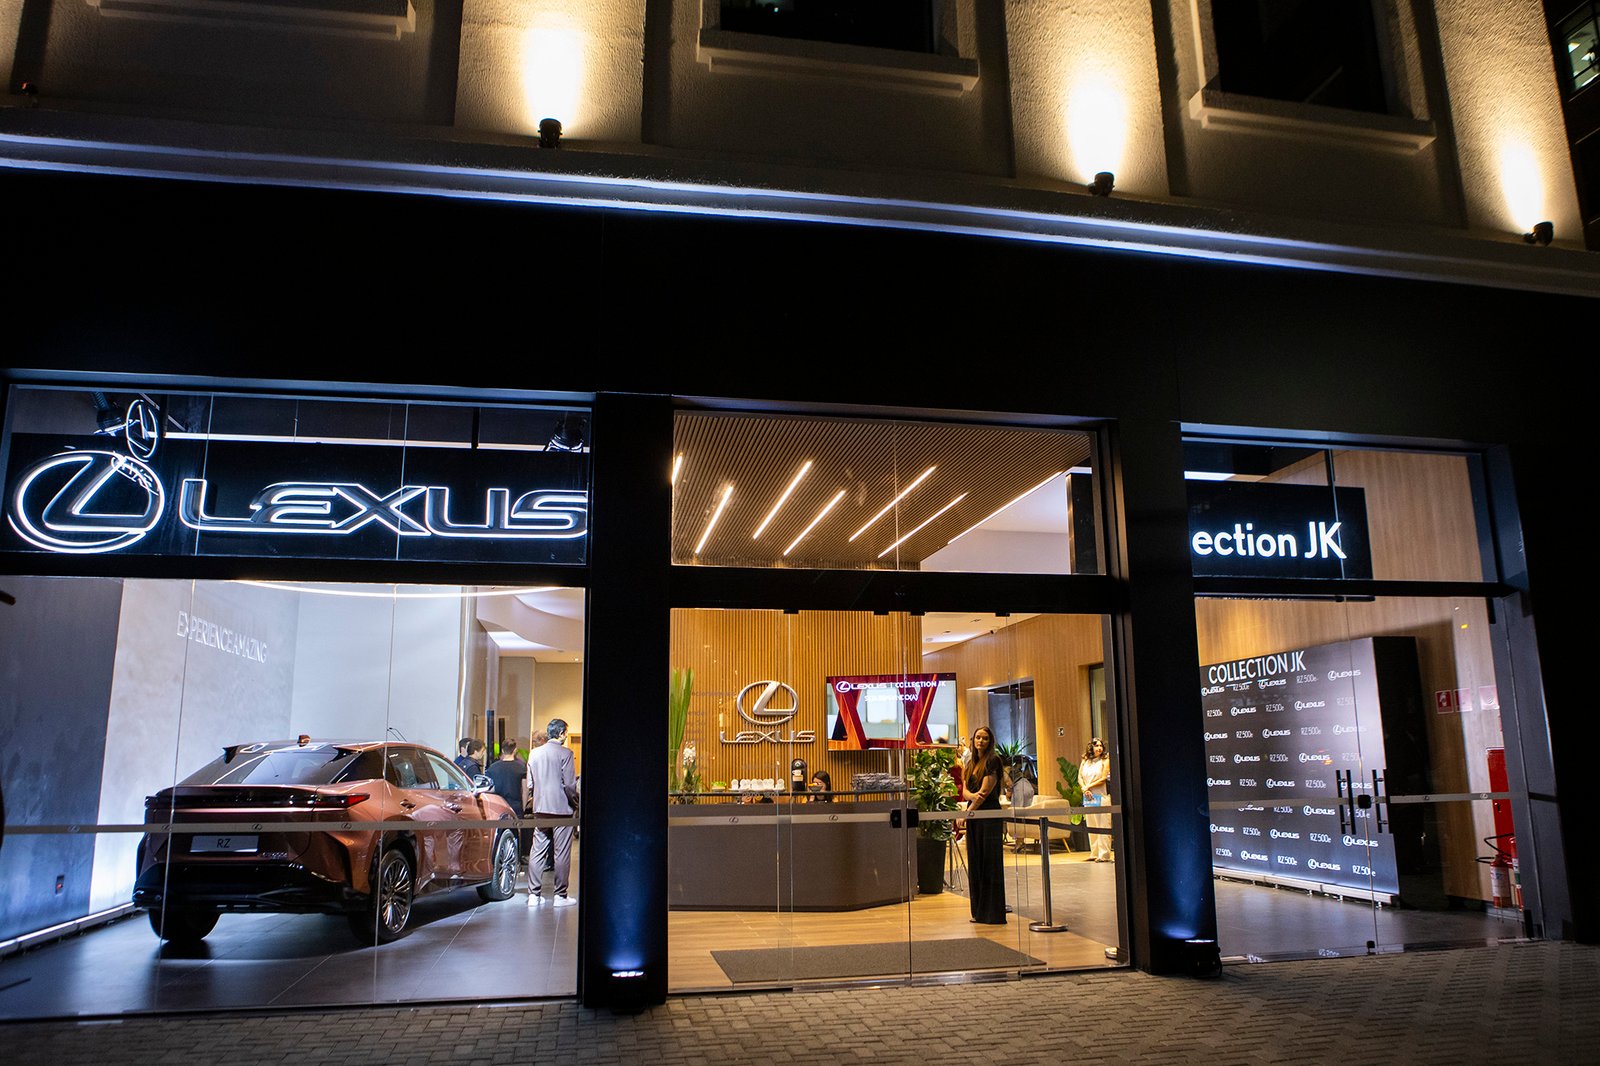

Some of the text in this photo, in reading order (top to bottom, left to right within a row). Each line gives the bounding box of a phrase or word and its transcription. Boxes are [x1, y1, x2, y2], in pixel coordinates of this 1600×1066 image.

[178, 477, 588, 539] LEXUS
[1304, 521, 1347, 559] JK
[177, 610, 267, 663] EXPERIENCE AMAZING
[1208, 650, 1307, 684] COLLECTION JK
[719, 730, 816, 745] LEXUS
[216, 838, 231, 848] RZ
